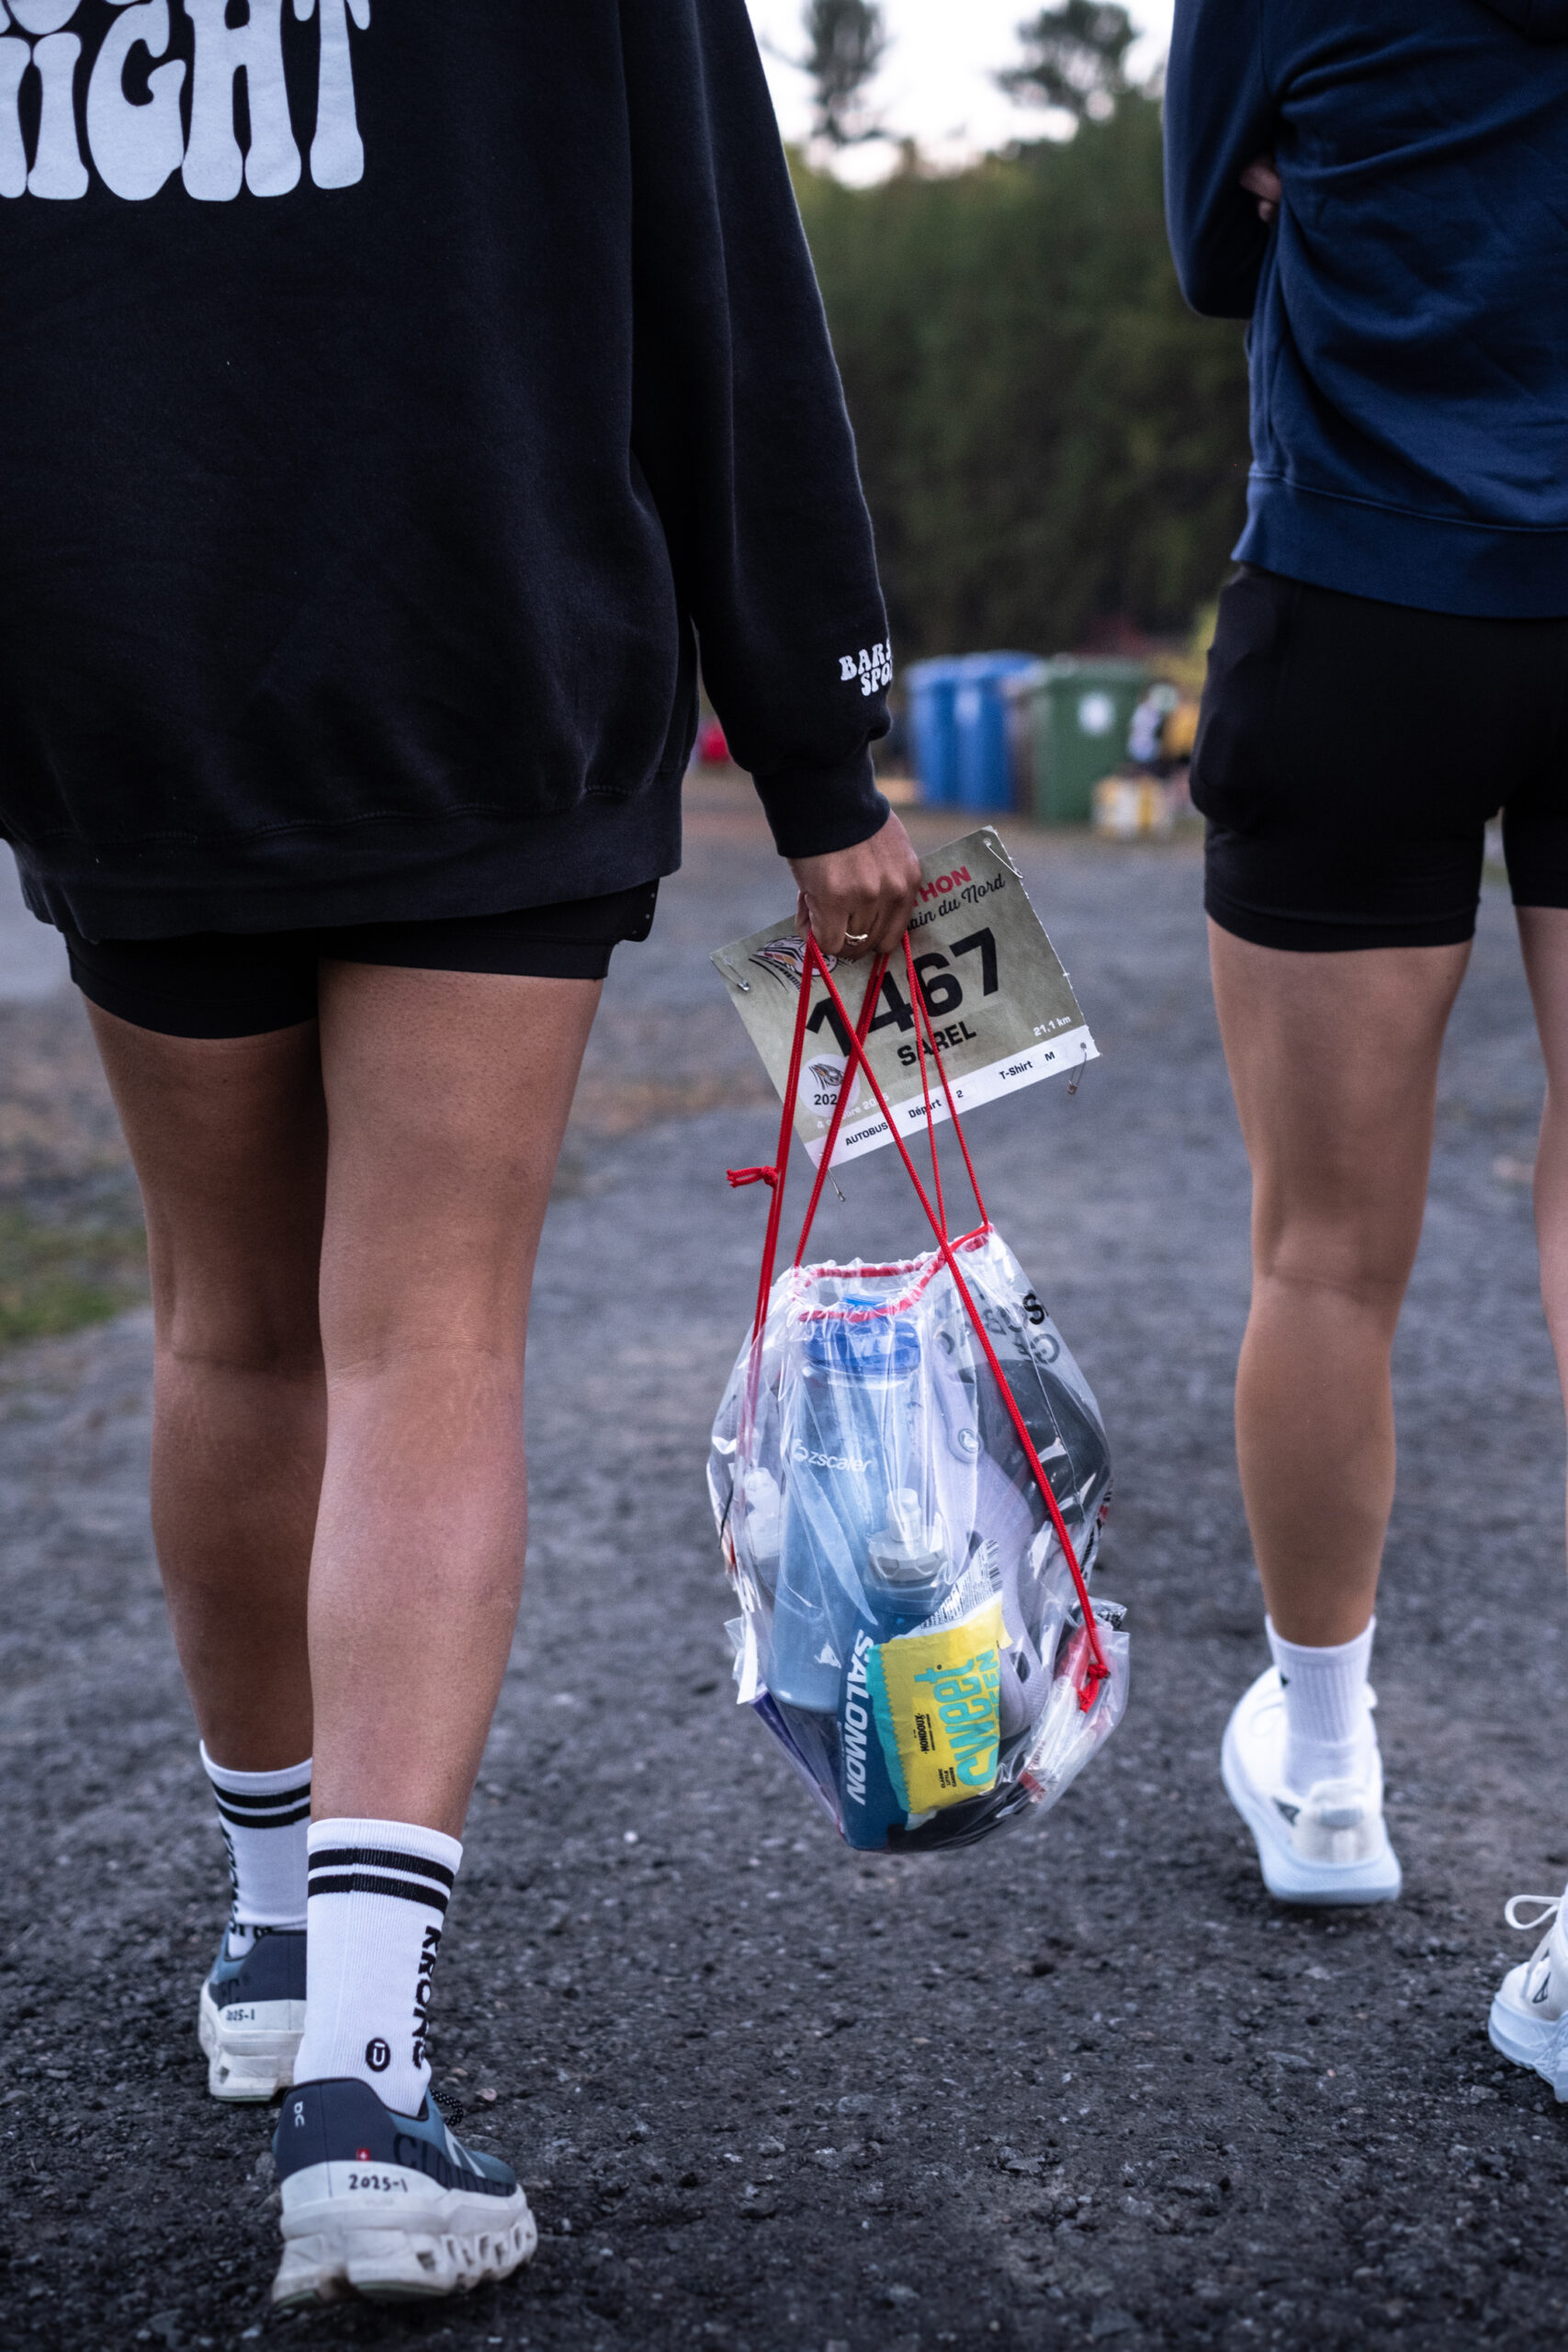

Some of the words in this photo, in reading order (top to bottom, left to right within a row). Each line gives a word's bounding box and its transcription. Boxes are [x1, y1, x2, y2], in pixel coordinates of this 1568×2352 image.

[861, 662, 893, 696] SPO
[907, 910, 936, 931] ain
[939, 899, 961, 916] du
[961, 873, 1006, 903] Nord
[914, 865, 972, 908] HON
[1056, 1015, 1071, 1027] km
[814, 1093, 838, 1106] 202
[845, 1122, 889, 1147] AUTOBUS
[956, 1090, 964, 1099] 2
[999, 1060, 1033, 1080] T-Shirt
[1044, 1051, 1055, 1061] M
[844, 1629, 874, 1805] SALOMON
[915, 1714, 931, 1752] MONDOUX
